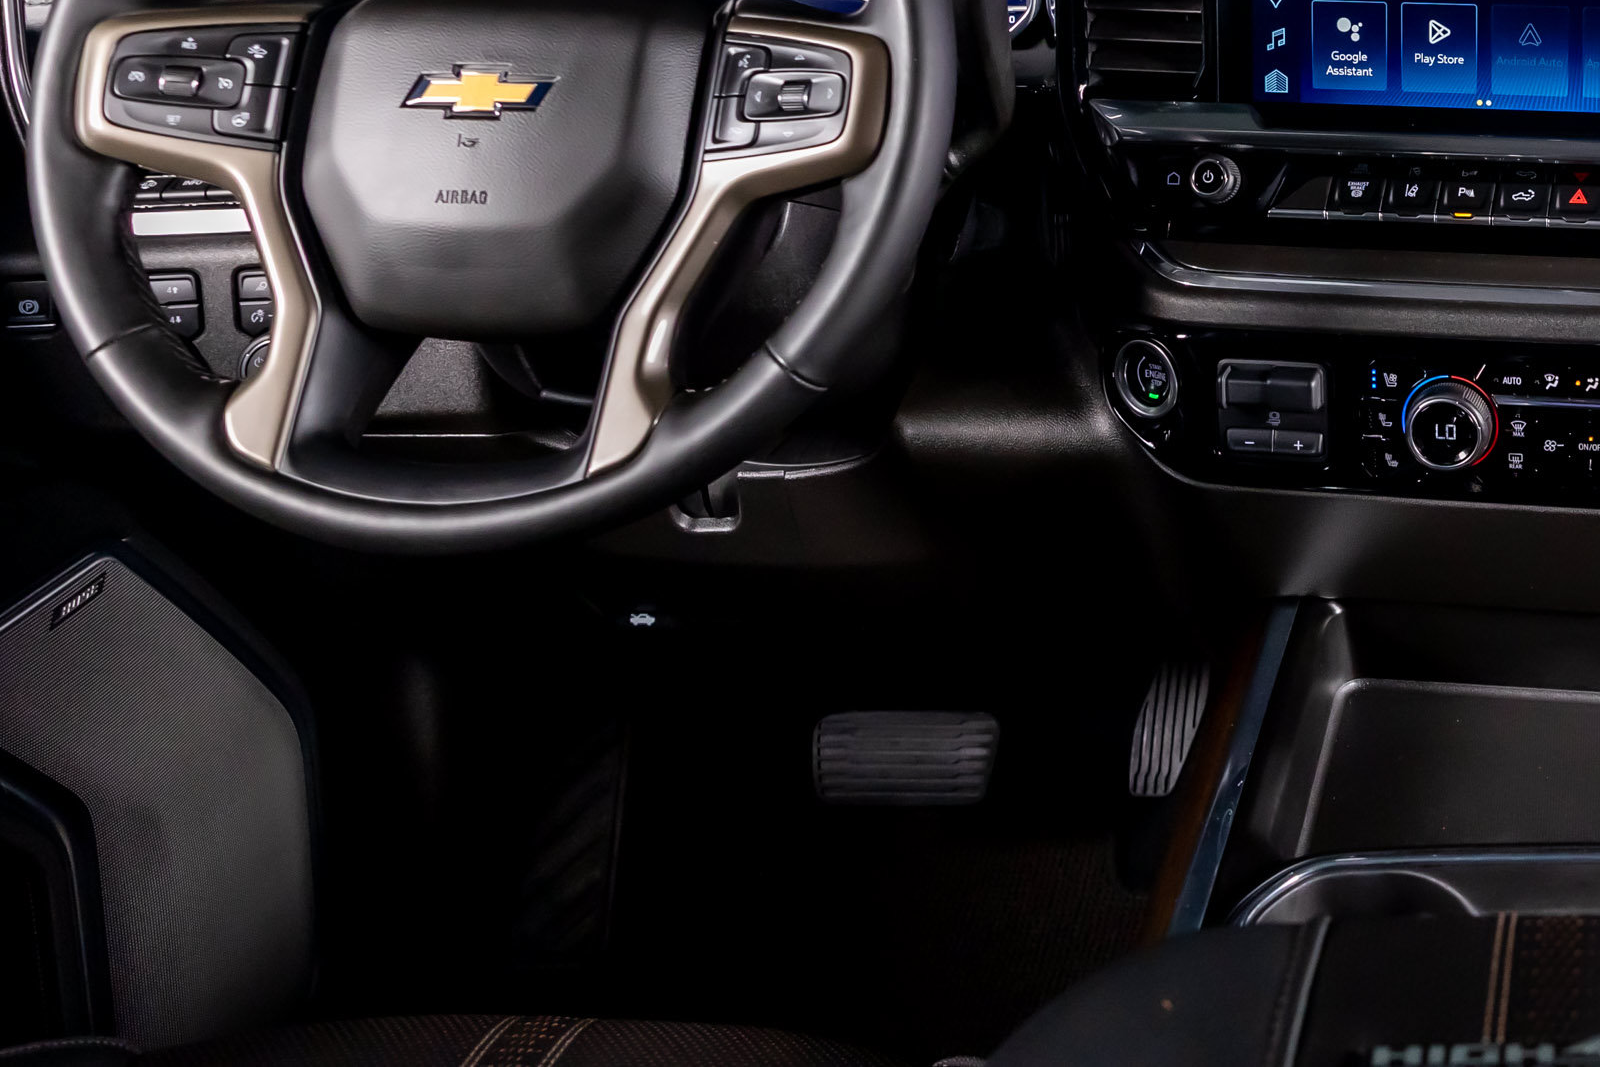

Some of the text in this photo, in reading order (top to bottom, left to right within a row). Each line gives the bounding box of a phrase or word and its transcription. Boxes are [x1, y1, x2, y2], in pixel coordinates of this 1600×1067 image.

[1330, 50, 1368, 64] Google
[1414, 52, 1465, 67] Play Store
[1496, 55, 1564, 69] Android Auto
[1325, 65, 1374, 77] Assistant
[434, 189, 489, 205] AIRBAG
[1144, 369, 1167, 383] ENGINE
[1150, 378, 1164, 387] STOP
[1502, 376, 1522, 386] AUTO
